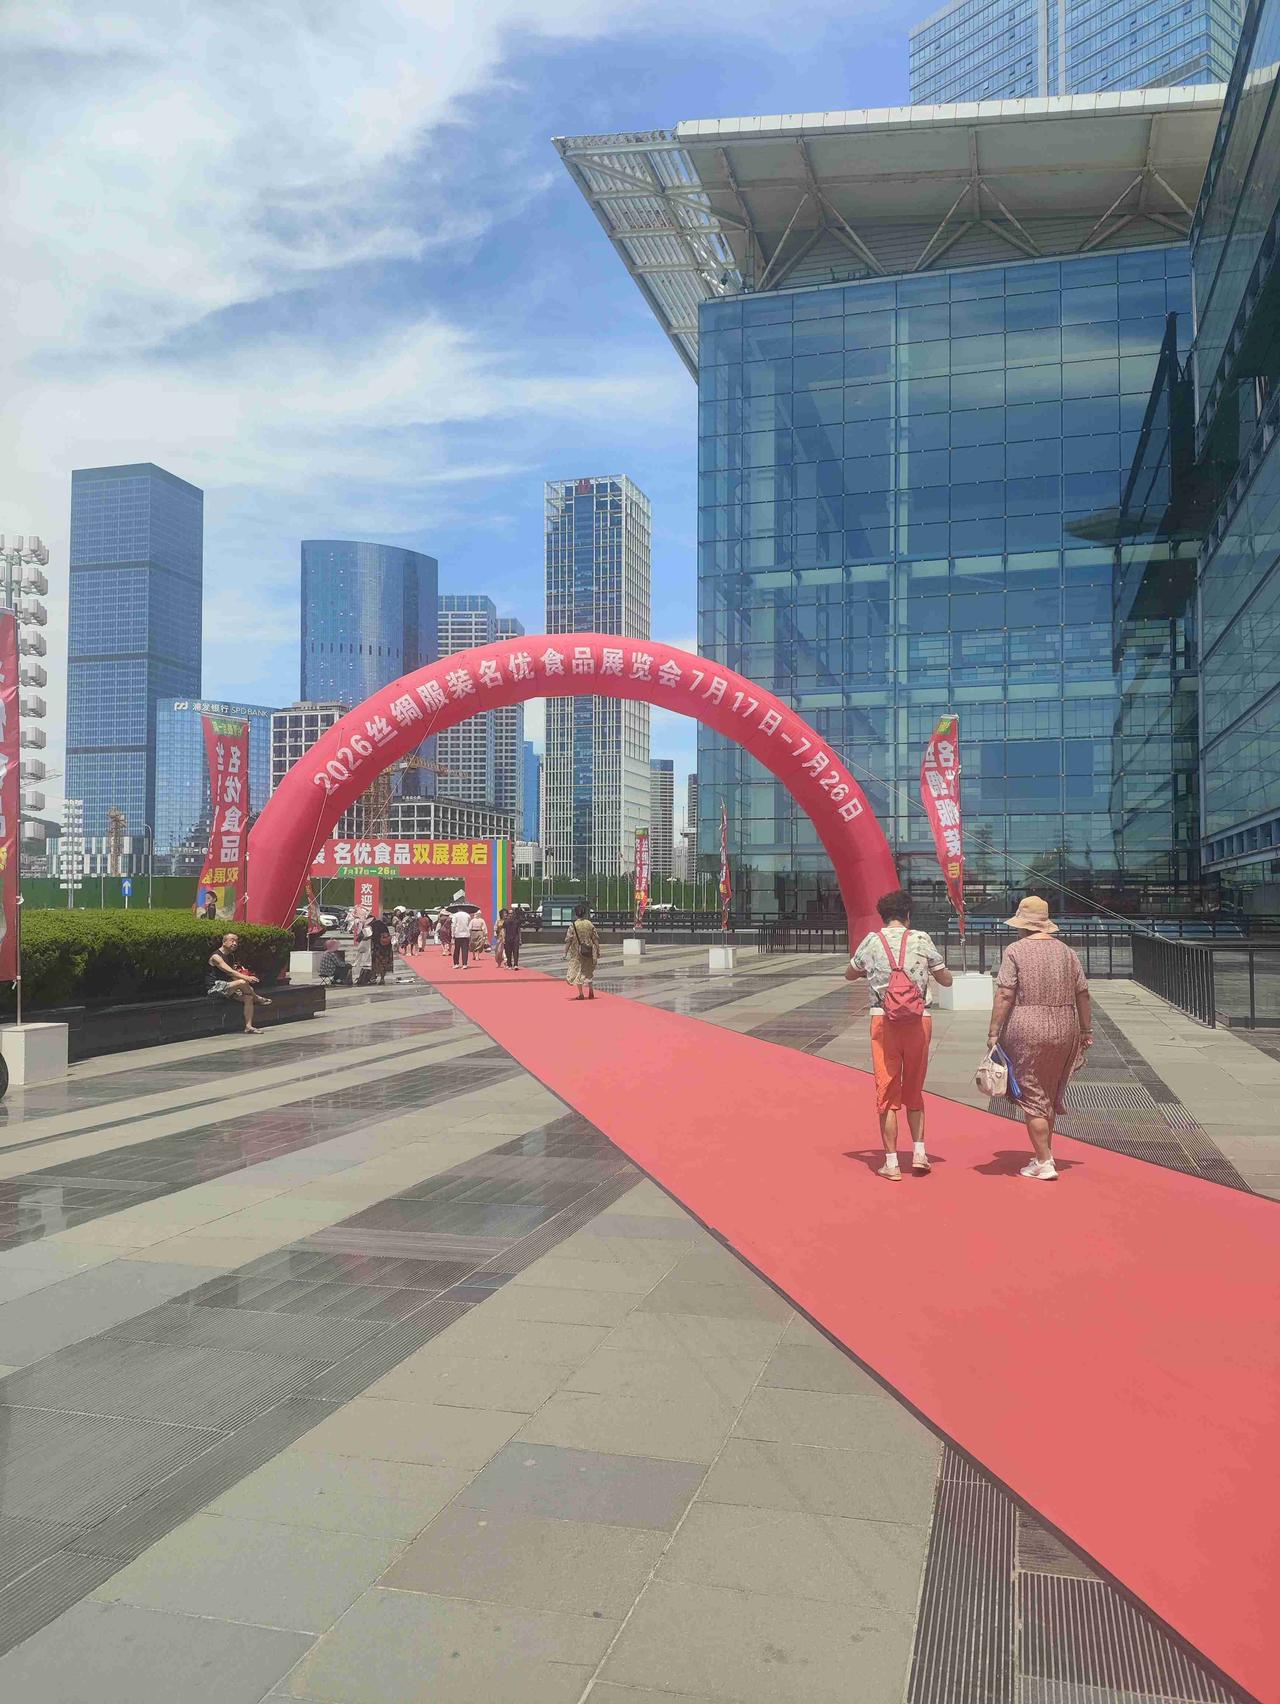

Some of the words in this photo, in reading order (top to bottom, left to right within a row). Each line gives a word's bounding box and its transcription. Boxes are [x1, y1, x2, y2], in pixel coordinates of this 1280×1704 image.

[193, 702, 229, 713] 浦发银行
[231, 707, 247, 715] SPD
[248, 709, 269, 718] BANK
[334, 842, 488, 865] 名优食品双展盛启
